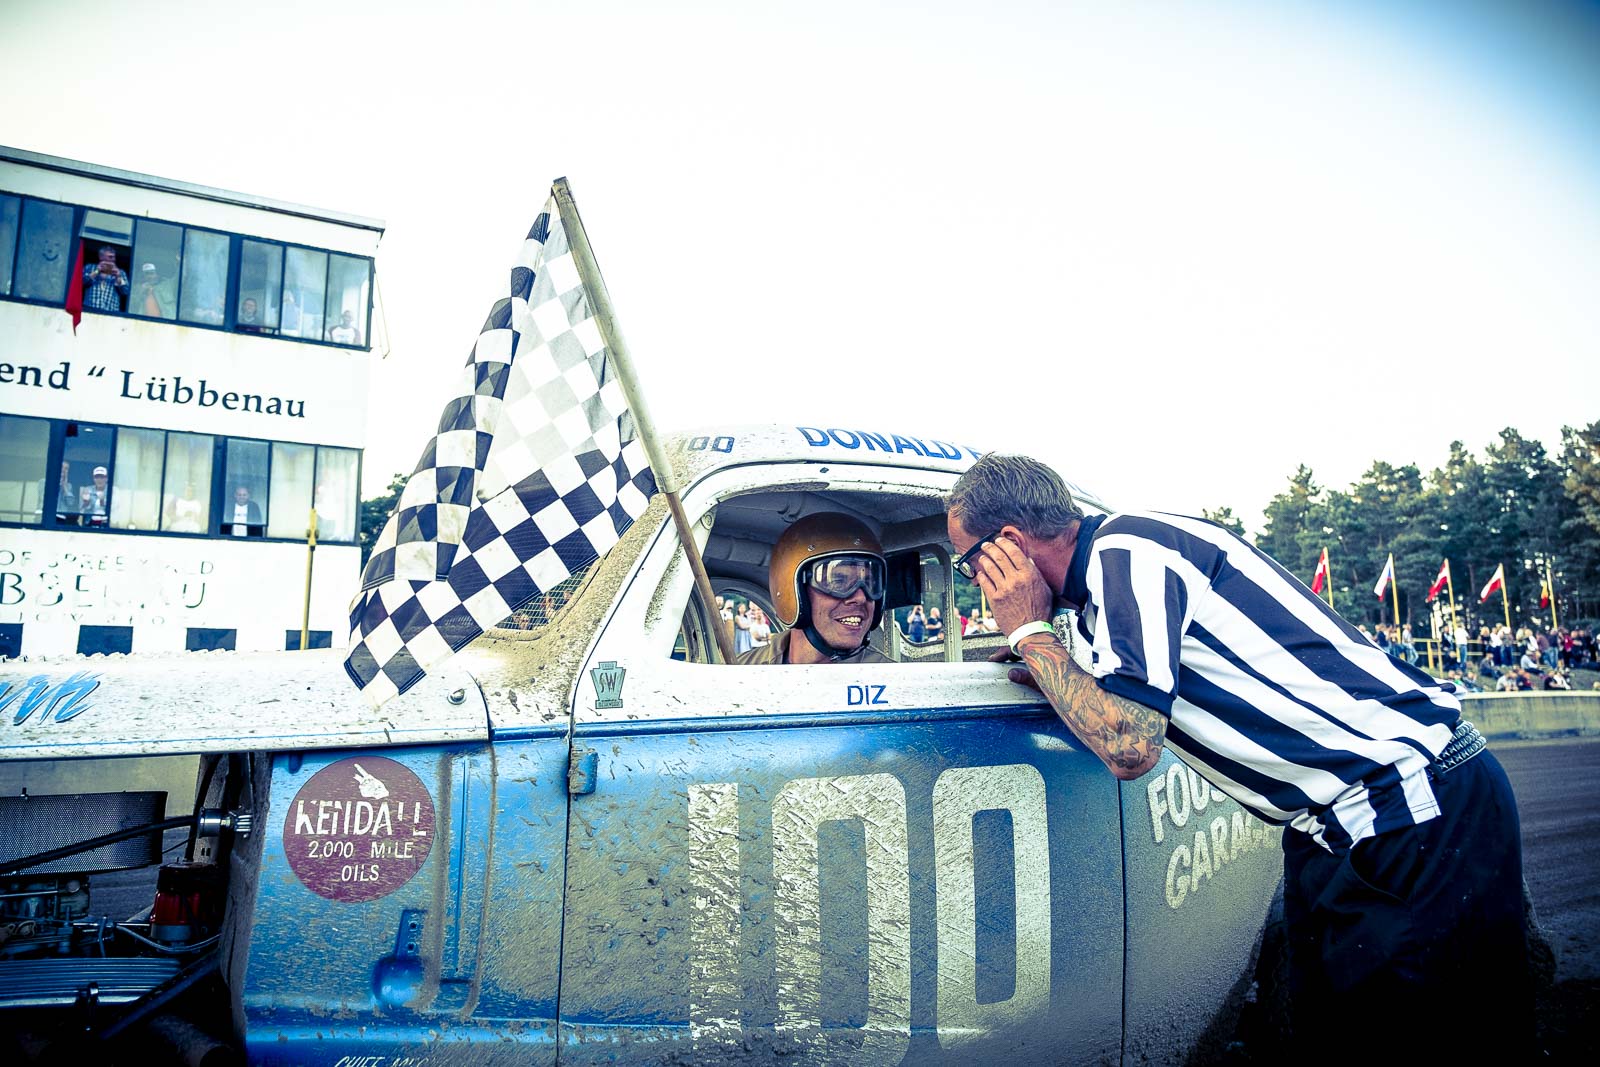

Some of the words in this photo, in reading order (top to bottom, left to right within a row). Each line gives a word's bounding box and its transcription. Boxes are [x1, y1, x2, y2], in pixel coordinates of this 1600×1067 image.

[120, 369, 305, 418] Lübbenau
[796, 426, 963, 461] DONALD
[847, 684, 889, 706] DIZ
[1147, 762, 1228, 843] FOU
[370, 841, 414, 859] MILE
[341, 864, 380, 882] OILS
[687, 763, 1052, 1067] 100
